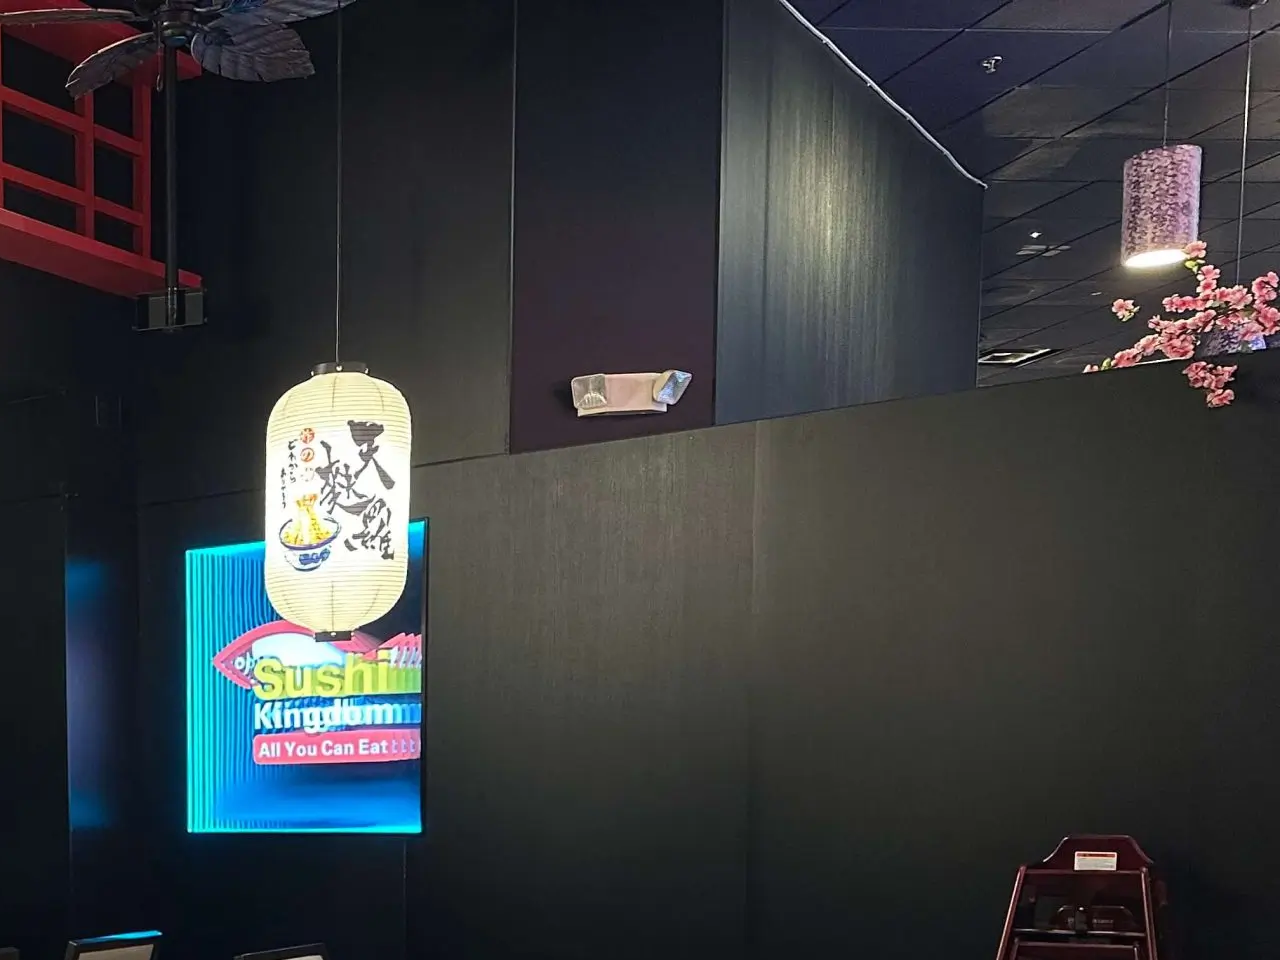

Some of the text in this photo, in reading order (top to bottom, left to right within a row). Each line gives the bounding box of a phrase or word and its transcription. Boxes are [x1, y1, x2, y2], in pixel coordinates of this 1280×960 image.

[253, 650, 390, 700] Sushi
[254, 697, 403, 734] Kingdom
[259, 739, 389, 758] All You Can Eat
